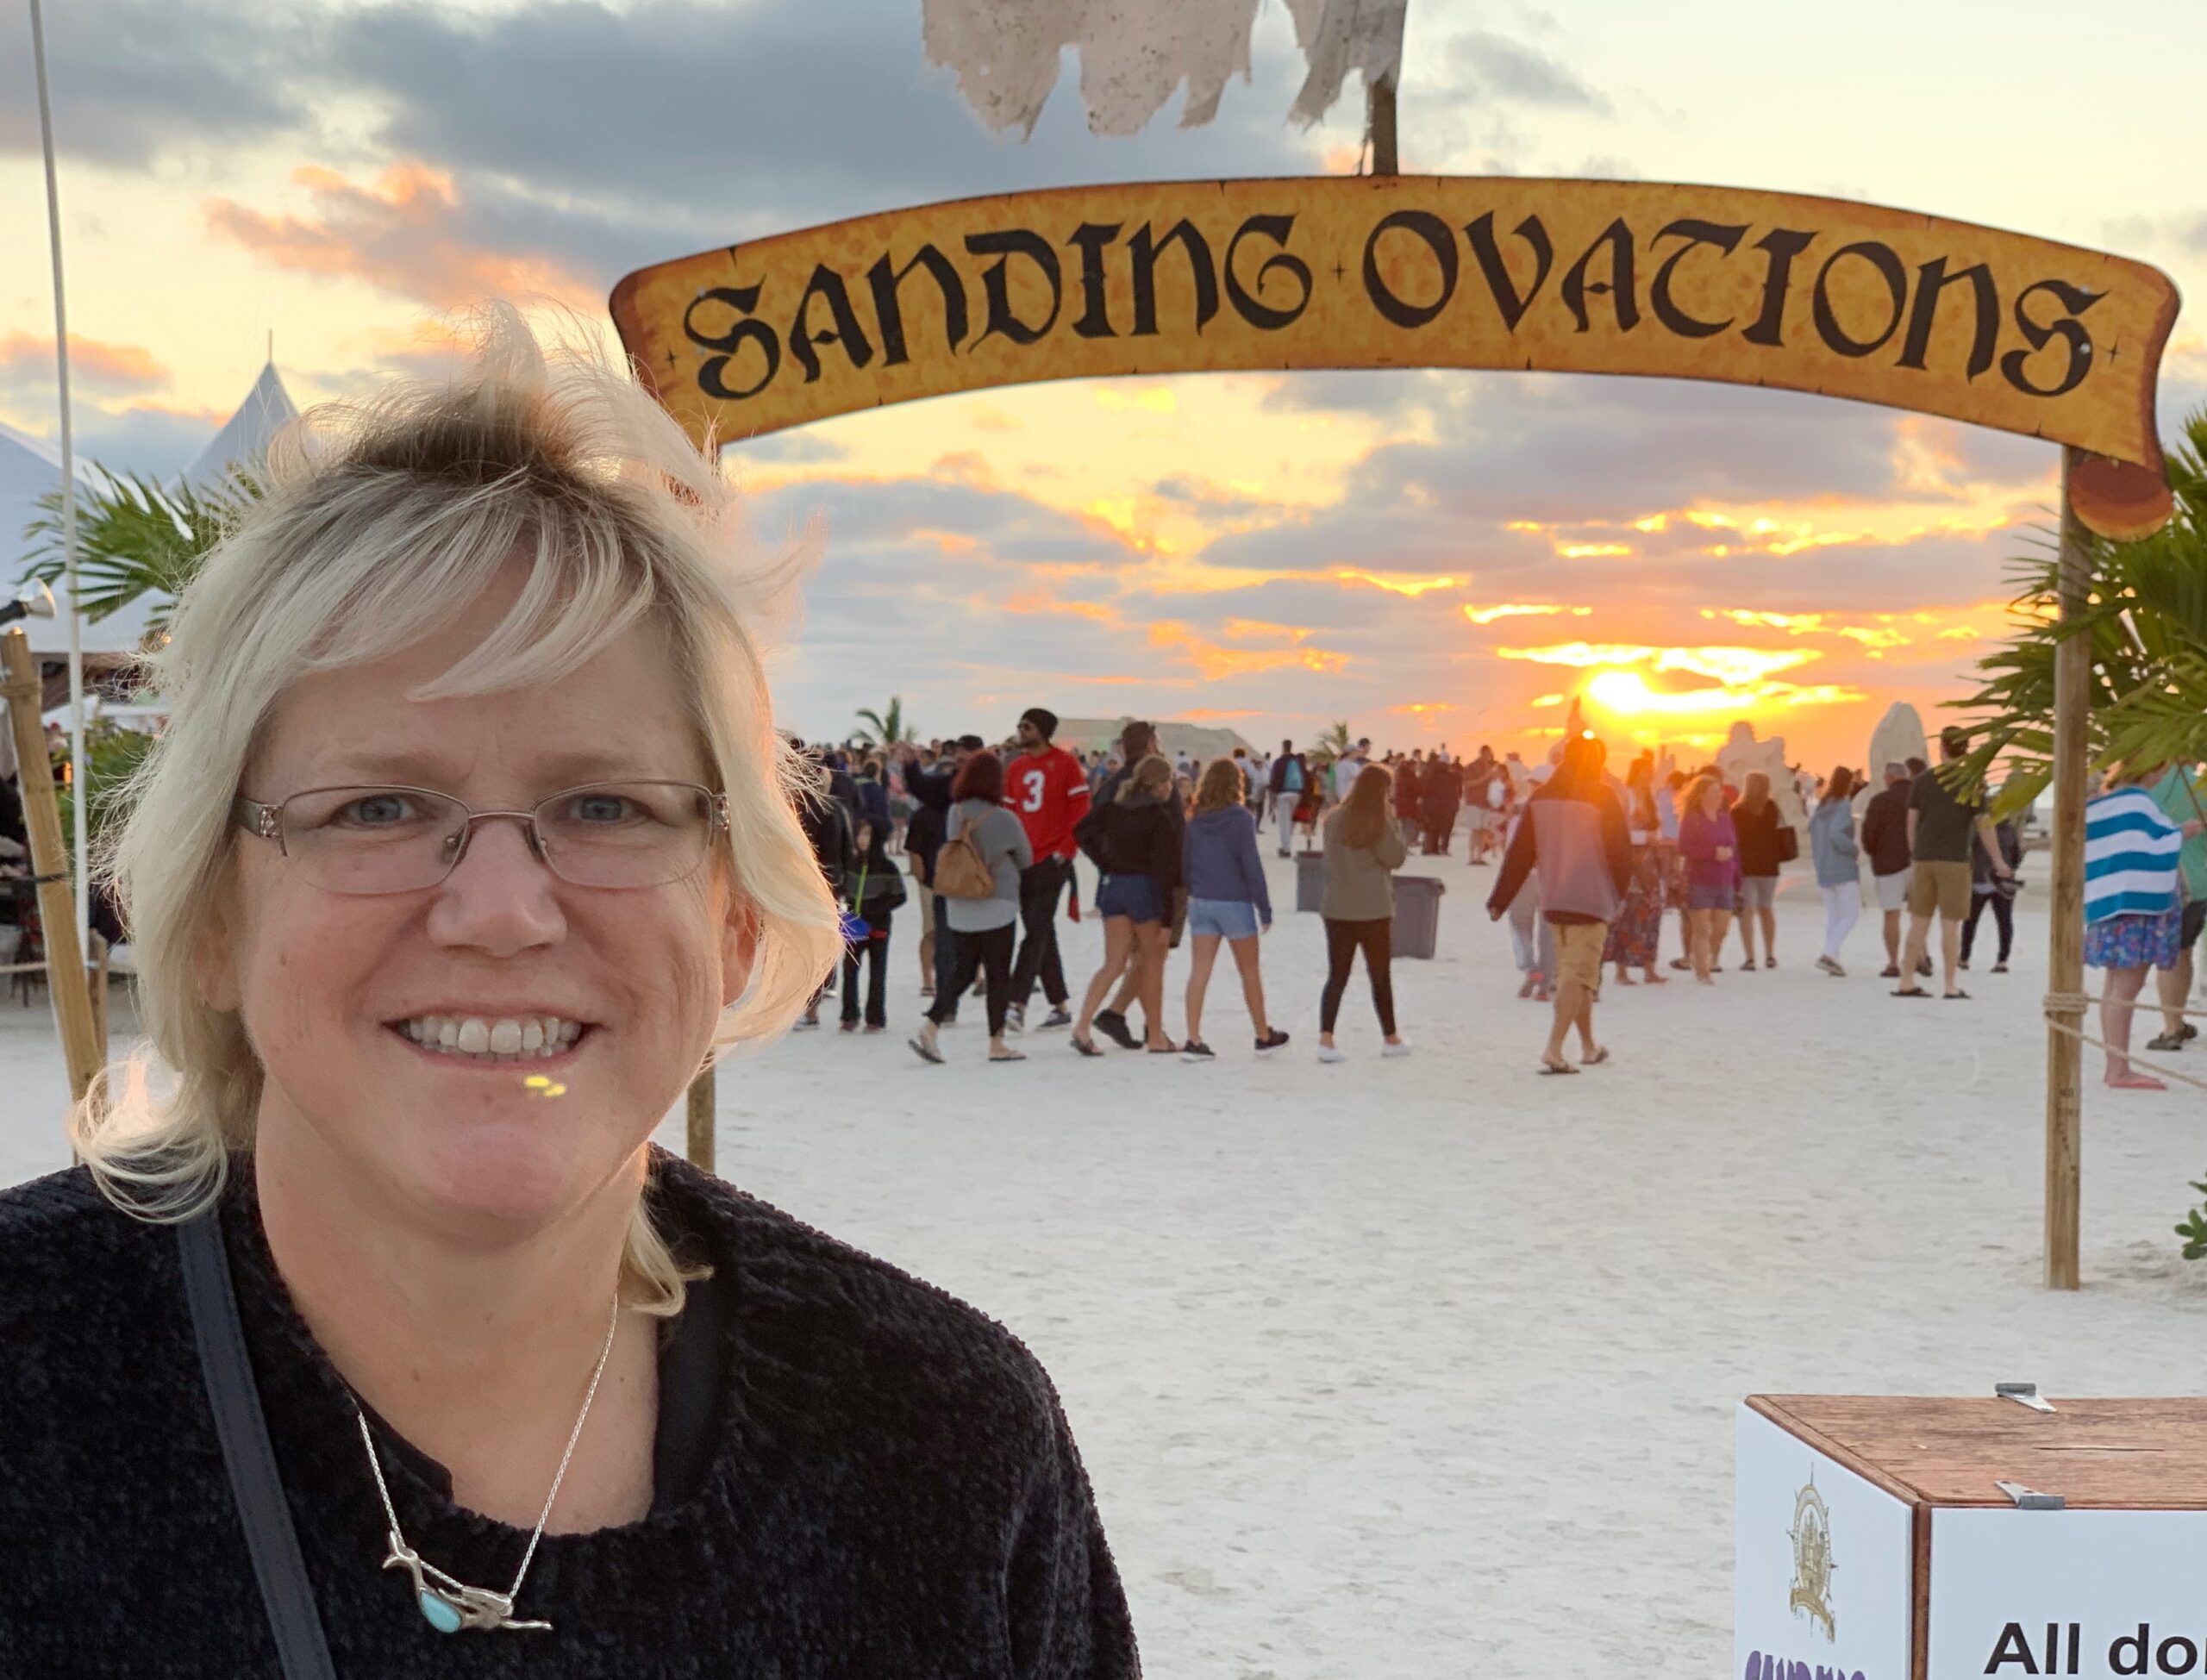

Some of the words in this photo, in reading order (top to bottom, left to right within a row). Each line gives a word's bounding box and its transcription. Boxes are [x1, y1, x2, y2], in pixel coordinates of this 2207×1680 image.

[684, 213, 1313, 401] SANDING
[1362, 210, 2107, 397] OVATIONS
[1022, 770, 1045, 813] 3
[1984, 1622, 2080, 1675] All
[2109, 1623, 2207, 1676] do
